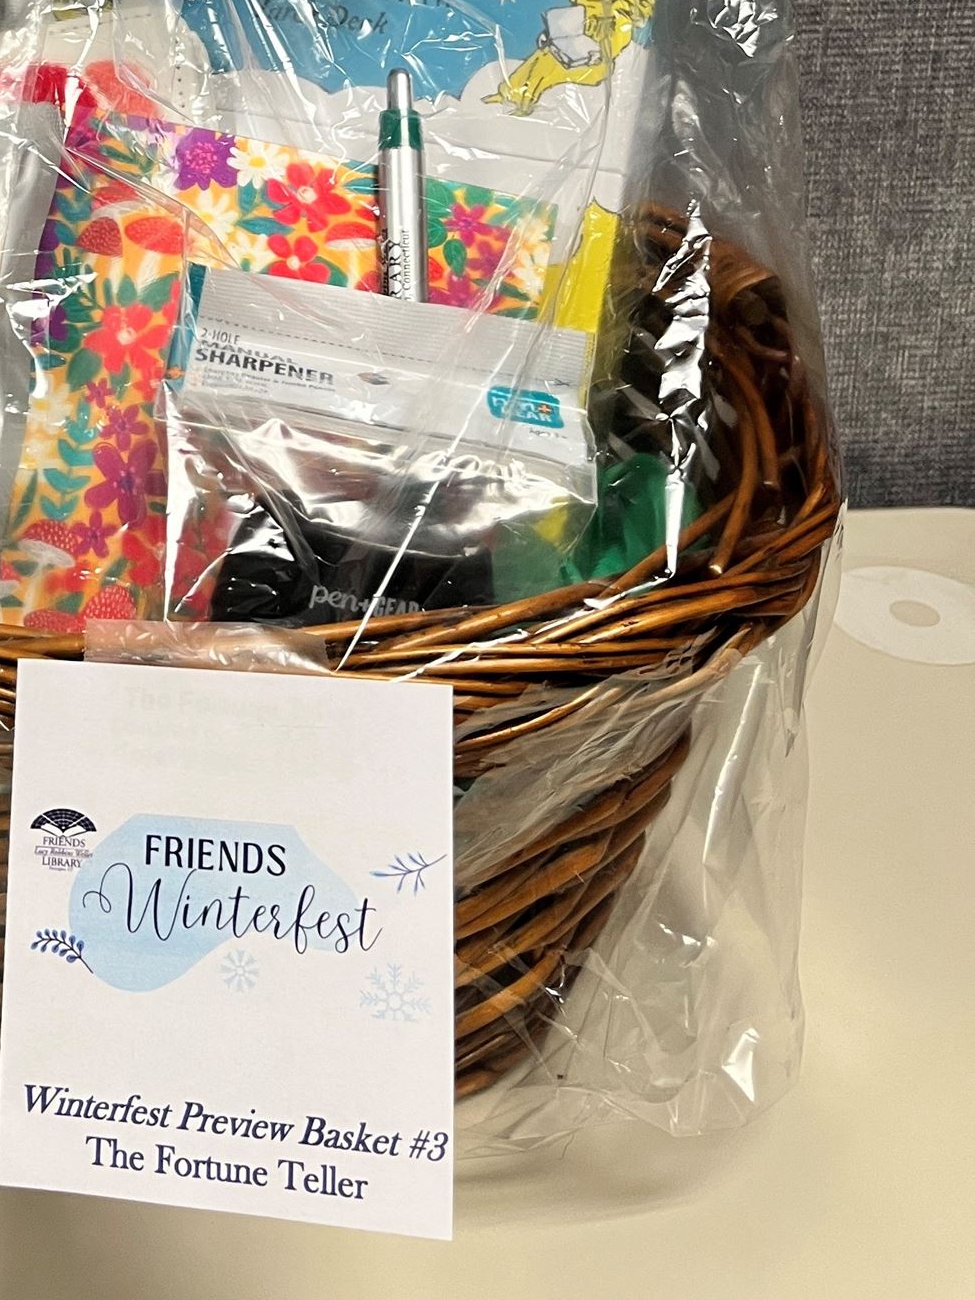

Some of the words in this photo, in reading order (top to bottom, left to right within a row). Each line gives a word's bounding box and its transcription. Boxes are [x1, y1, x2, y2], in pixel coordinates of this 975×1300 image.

[195, 348, 335, 386] SHARPENER
[42, 856, 81, 868] LIBRARY
[43, 836, 86, 848] FRIENDS
[145, 834, 286, 876] FRIENDS
[83, 863, 383, 954] Winterfest
[25, 1084, 172, 1129] Winterfest
[177, 1101, 294, 1143] Preview
[299, 1116, 403, 1157] Basket
[409, 1129, 449, 1162] #3
[86, 1136, 145, 1172] The
[154, 1144, 269, 1188] Fortune
[277, 1159, 369, 1200] Teller
